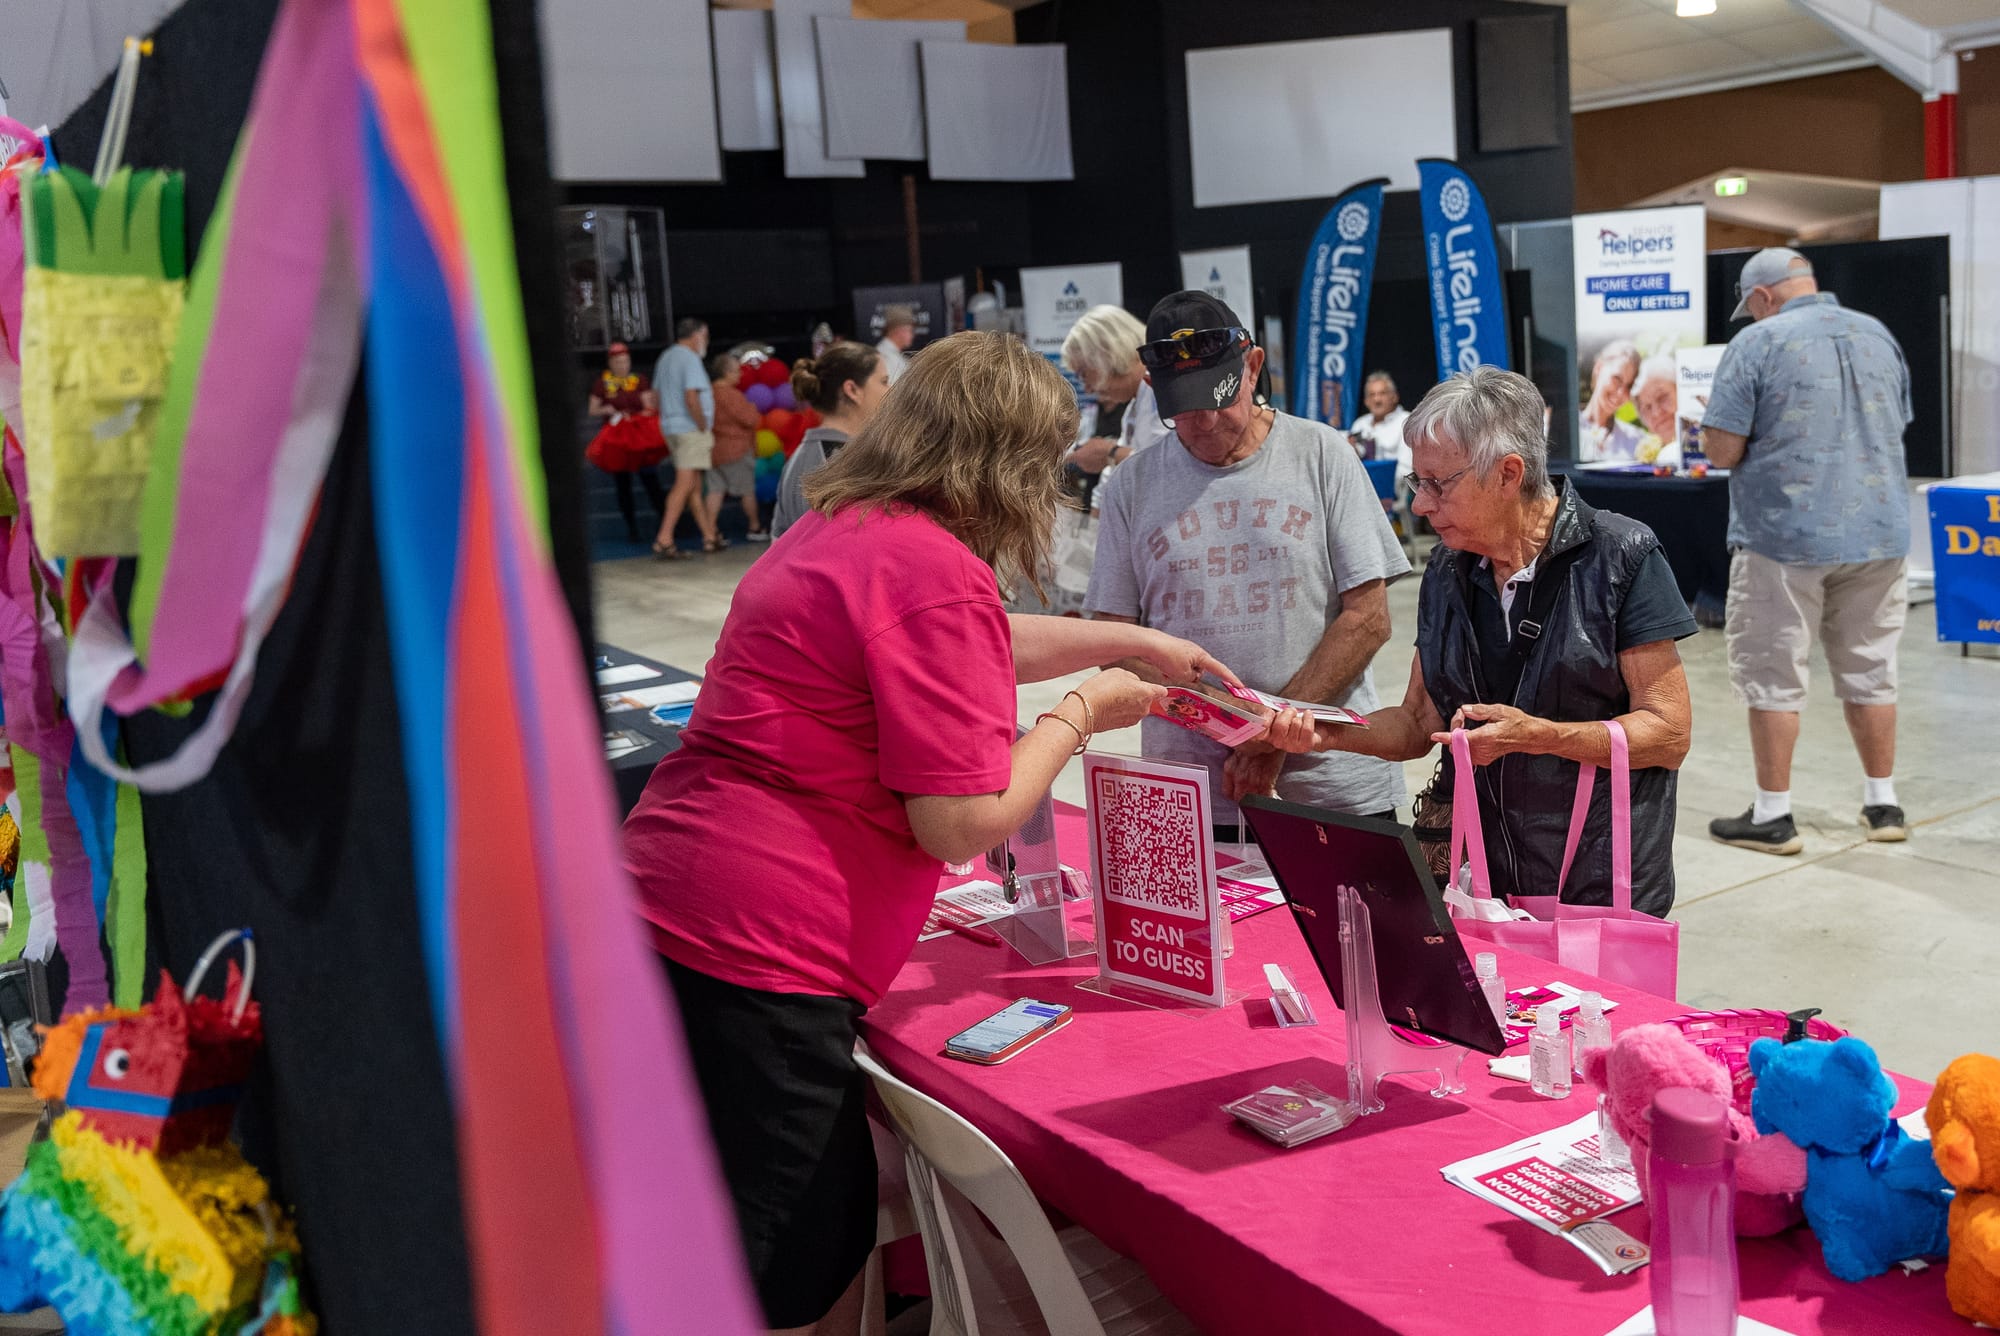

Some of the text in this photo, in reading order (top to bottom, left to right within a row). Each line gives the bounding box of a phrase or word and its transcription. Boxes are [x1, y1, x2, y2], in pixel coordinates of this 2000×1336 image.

[1602, 232, 1675, 258] Helpers
[1445, 223, 1482, 376] Lifeline
[1591, 275, 1664, 292] HOME CARE
[1606, 294, 1686, 310] ONLY BETTER
[1322, 244, 1365, 378] Lifeline
[1147, 498, 1312, 561] SOUTH
[1207, 543, 1249, 577] 56
[1161, 576, 1302, 621] COAST
[1130, 918, 1184, 948] SCAN
[1113, 939, 1205, 980] TO GUESS
[1517, 1166, 1601, 1210] WORKSHOPS
[1529, 1161, 1566, 1181] SOON
[1485, 1177, 1571, 1223] EDUCATION
[1503, 1172, 1587, 1216] & TRAINING
[1563, 1179, 1615, 1205] COMING
